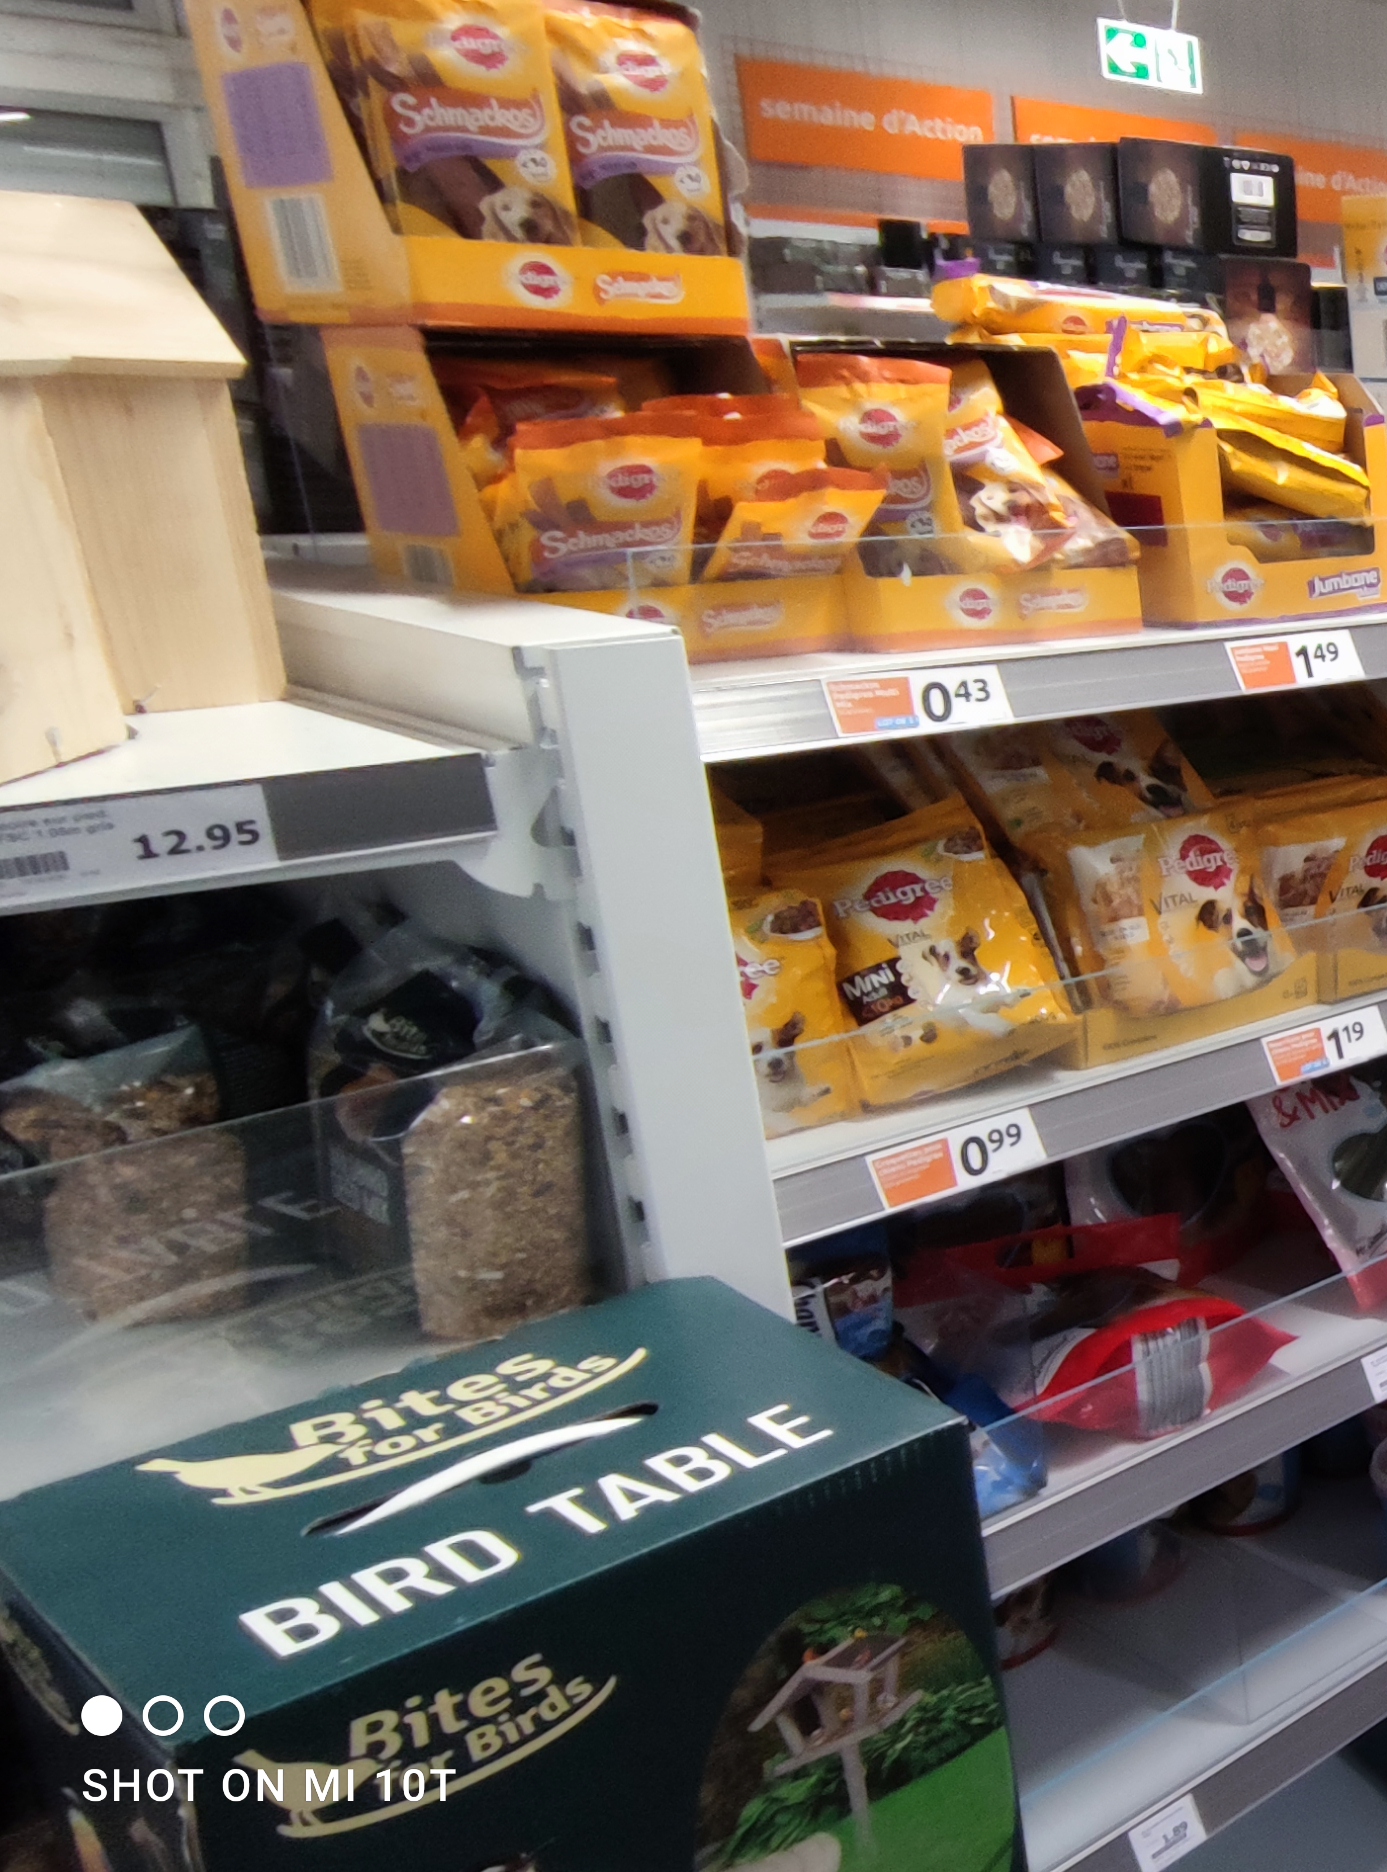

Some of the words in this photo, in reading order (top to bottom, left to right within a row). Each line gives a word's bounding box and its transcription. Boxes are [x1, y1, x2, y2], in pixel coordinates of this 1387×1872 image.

[390, 92, 541, 136] Schmackos
[570, 115, 692, 155] Schmackos
[761, 99, 876, 131] semaine
[882, 108, 984, 143] d'Action
[132, 819, 261, 861] 12.95
[832, 875, 954, 918] Pedigree
[1150, 892, 1199, 915] VITAL
[887, 929, 932, 949] VITAL
[289, 1353, 559, 1448] Bites
[338, 1421, 446, 1467] for
[455, 1354, 619, 1427] Birds
[238, 1529, 521, 1659] BIRD
[525, 1403, 835, 1535] TABLE
[348, 1652, 554, 1761] Bites
[464, 1673, 595, 1764] Birds
